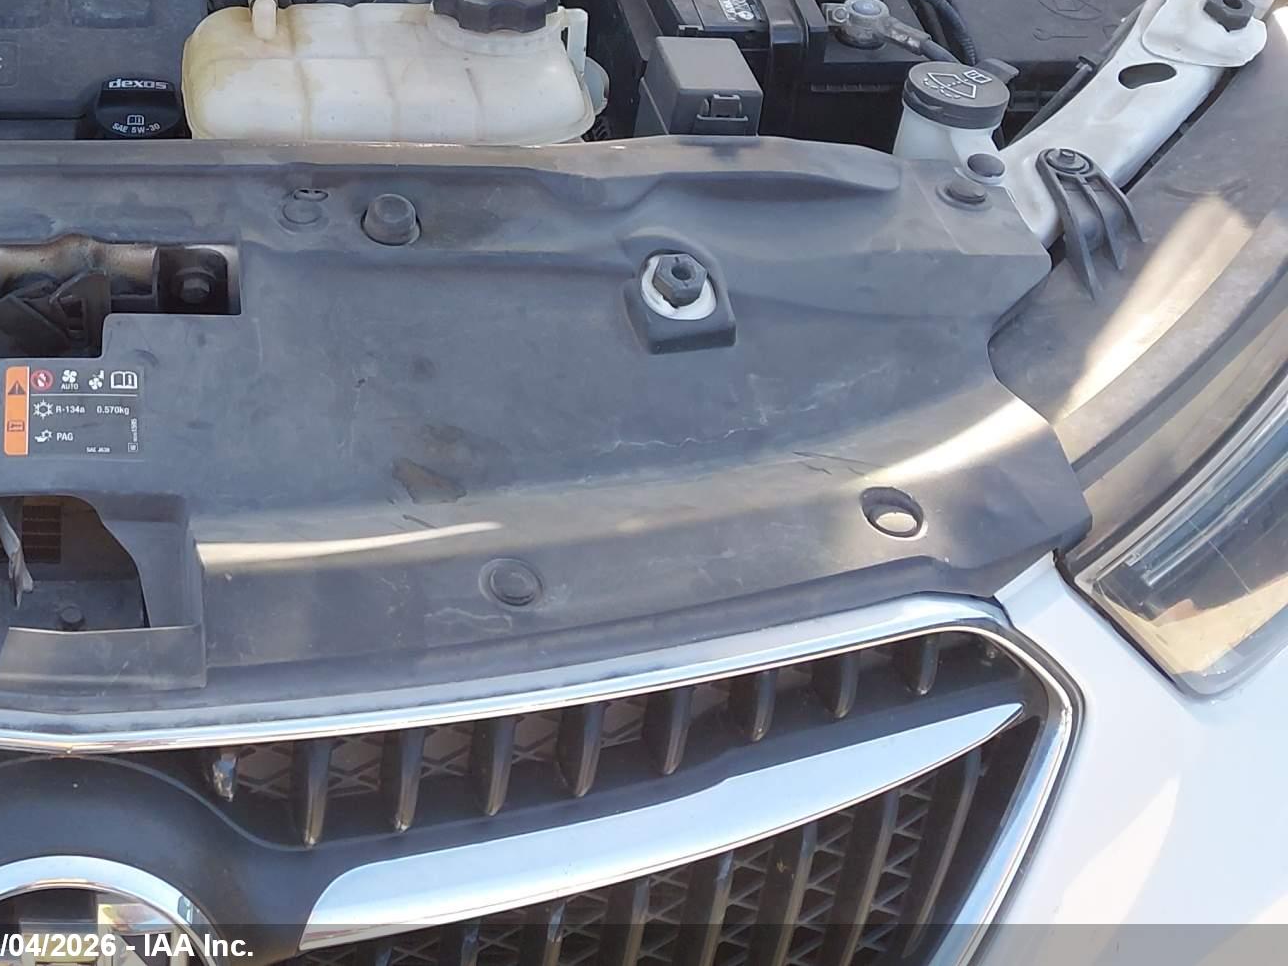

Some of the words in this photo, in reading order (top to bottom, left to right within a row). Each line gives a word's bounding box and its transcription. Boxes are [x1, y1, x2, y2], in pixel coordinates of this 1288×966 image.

[108, 77, 167, 91] dexos
[112, 122, 129, 133] SAE
[131, 122, 161, 134] 5W-30
[55, 405, 86, 414] R-134a
[96, 405, 130, 416] 0.570kg
[56, 432, 74, 442] PAG
